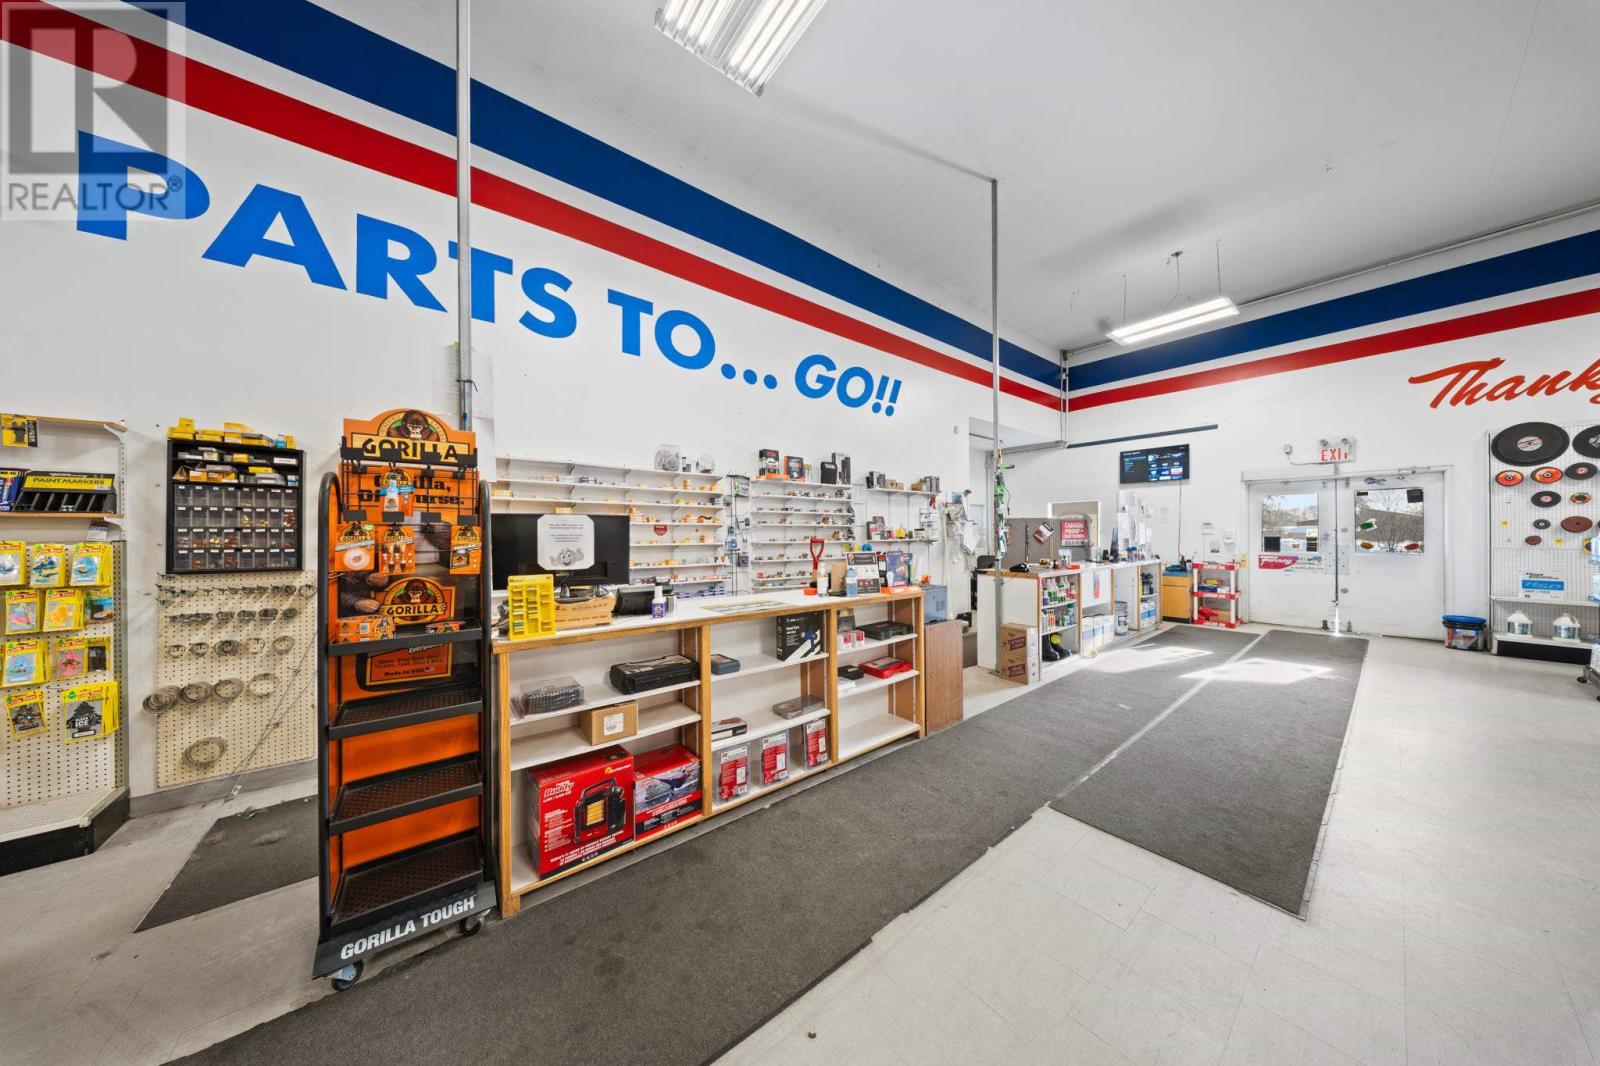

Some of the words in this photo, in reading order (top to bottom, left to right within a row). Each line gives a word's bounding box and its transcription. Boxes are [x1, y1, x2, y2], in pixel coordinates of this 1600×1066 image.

[76, 130, 578, 339] PARTS
[794, 354, 902, 417] GO!!
[1408, 357, 1600, 409] Thank
[387, 604, 438, 615] GORILLA
[340, 919, 416, 960] GORILLA
[420, 896, 475, 928] TOUGH
